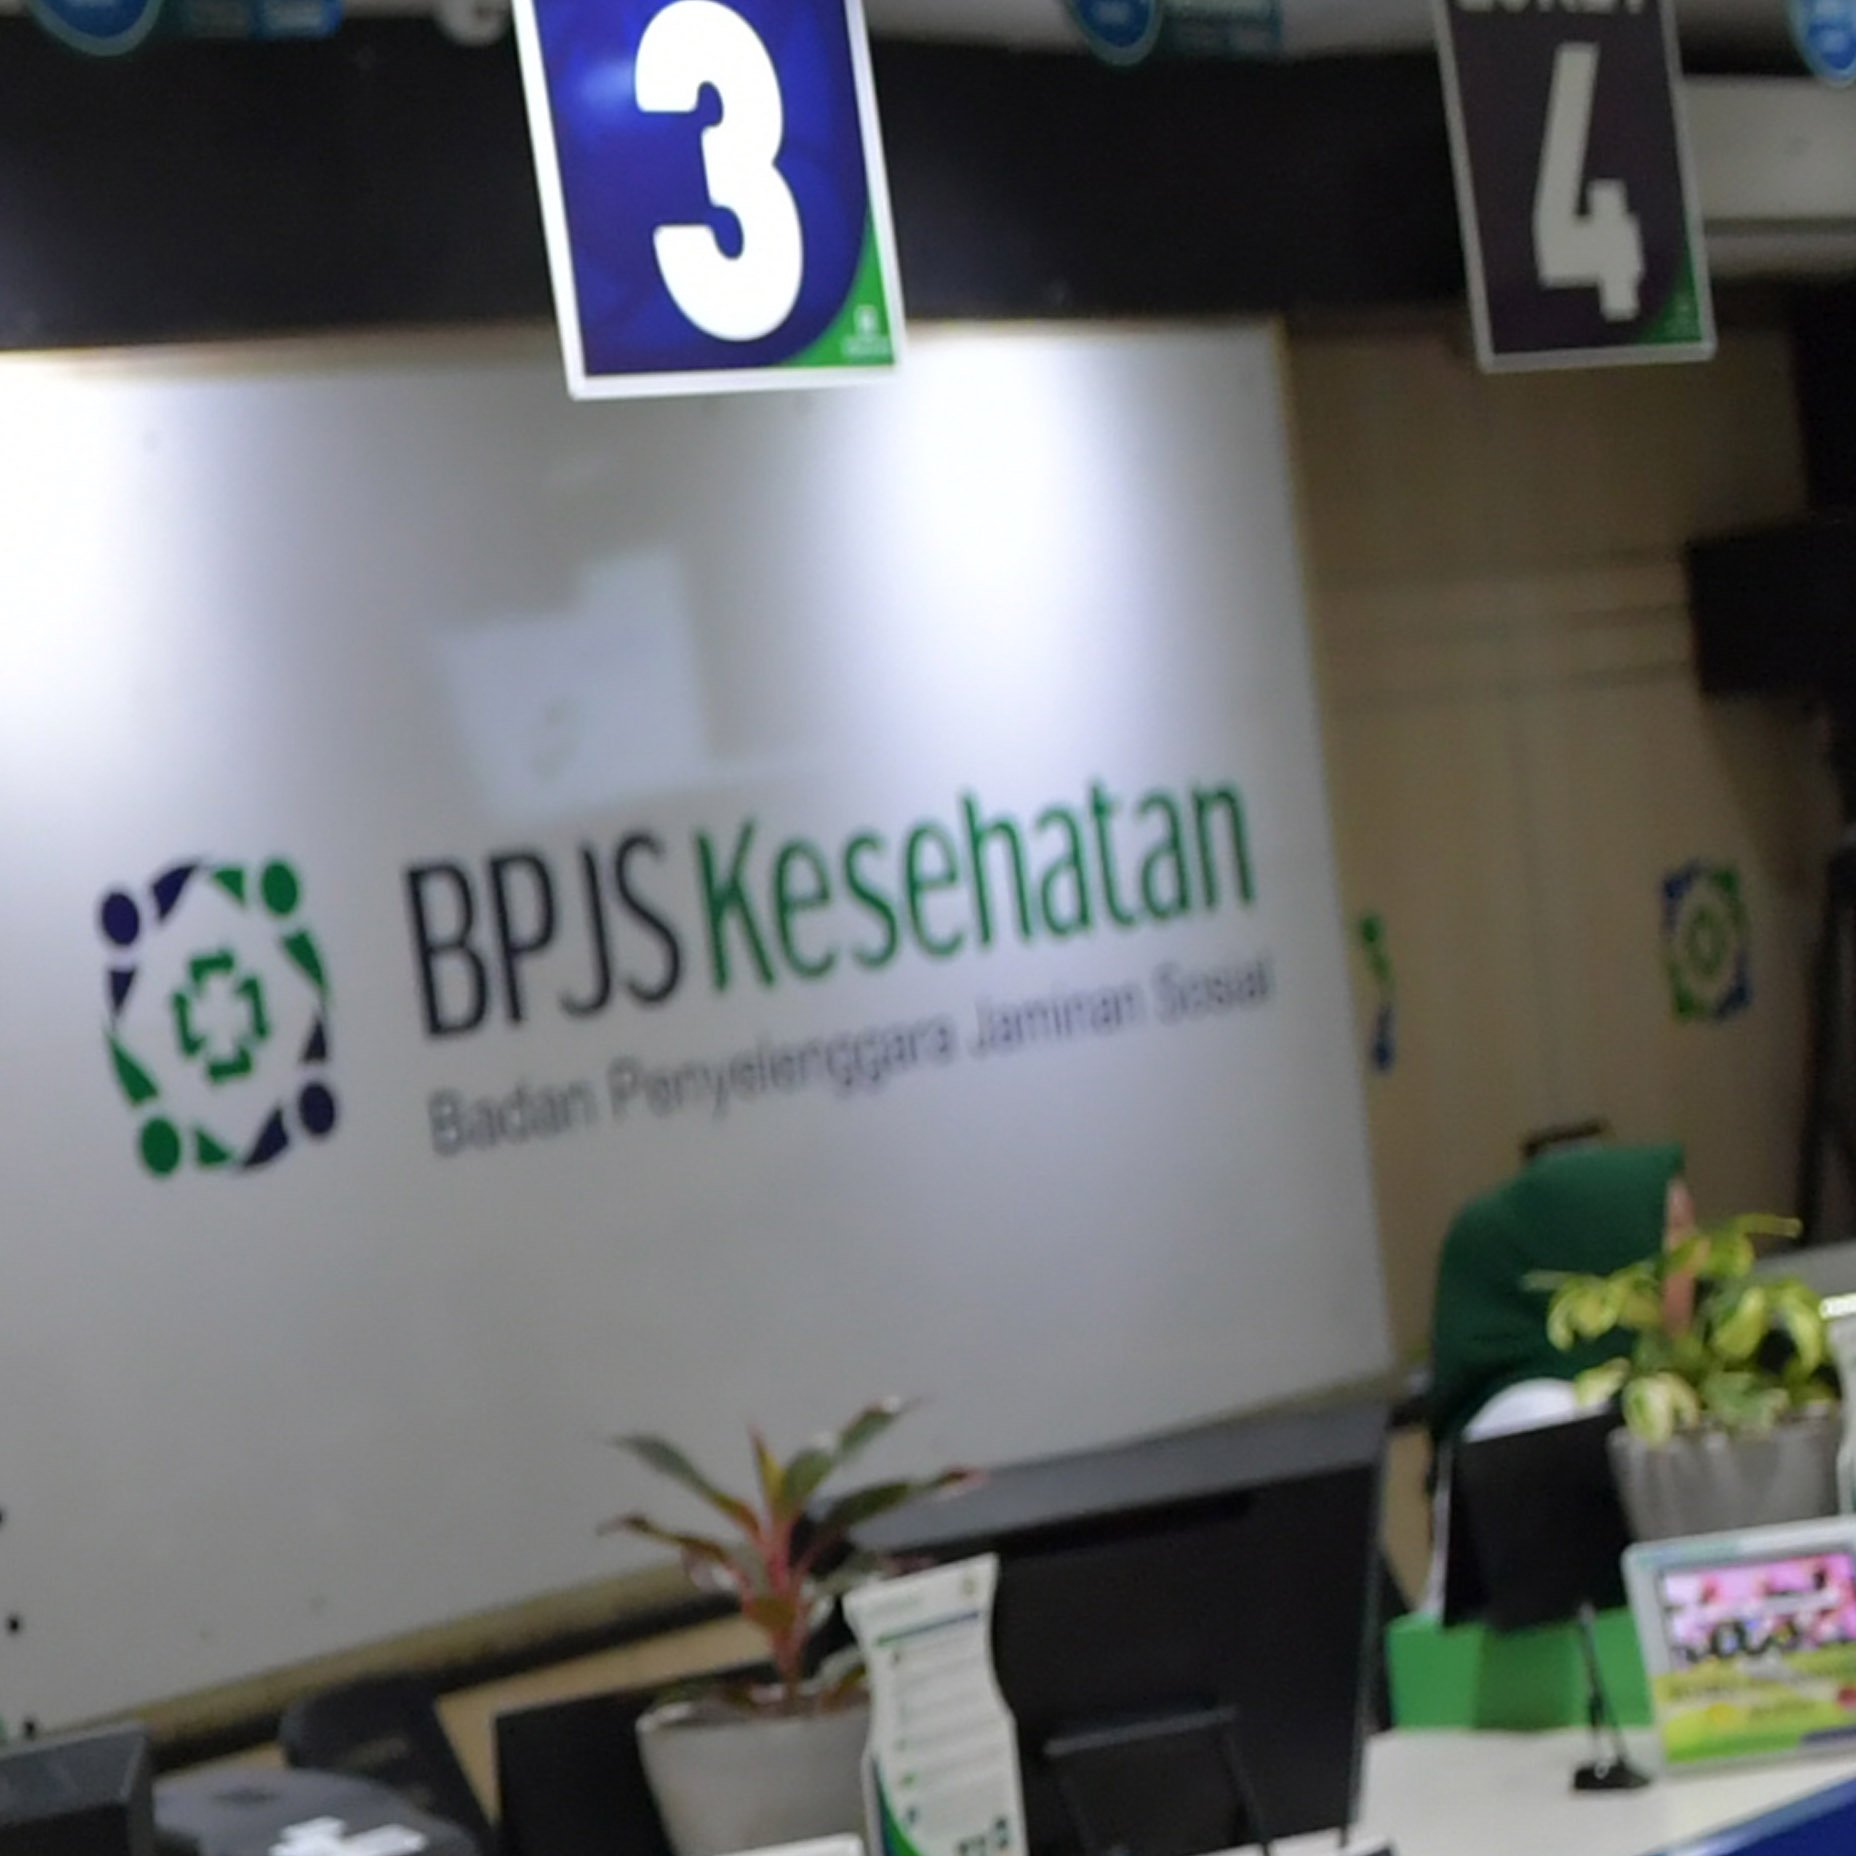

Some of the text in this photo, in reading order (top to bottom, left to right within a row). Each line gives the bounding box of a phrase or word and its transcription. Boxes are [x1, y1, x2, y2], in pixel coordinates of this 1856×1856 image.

[634, 0, 804, 341] 3
[1534, 42, 1645, 322] 4
[405, 775, 1256, 1038] BPJS Kesehatan
[428, 1077, 598, 1157] Badan
